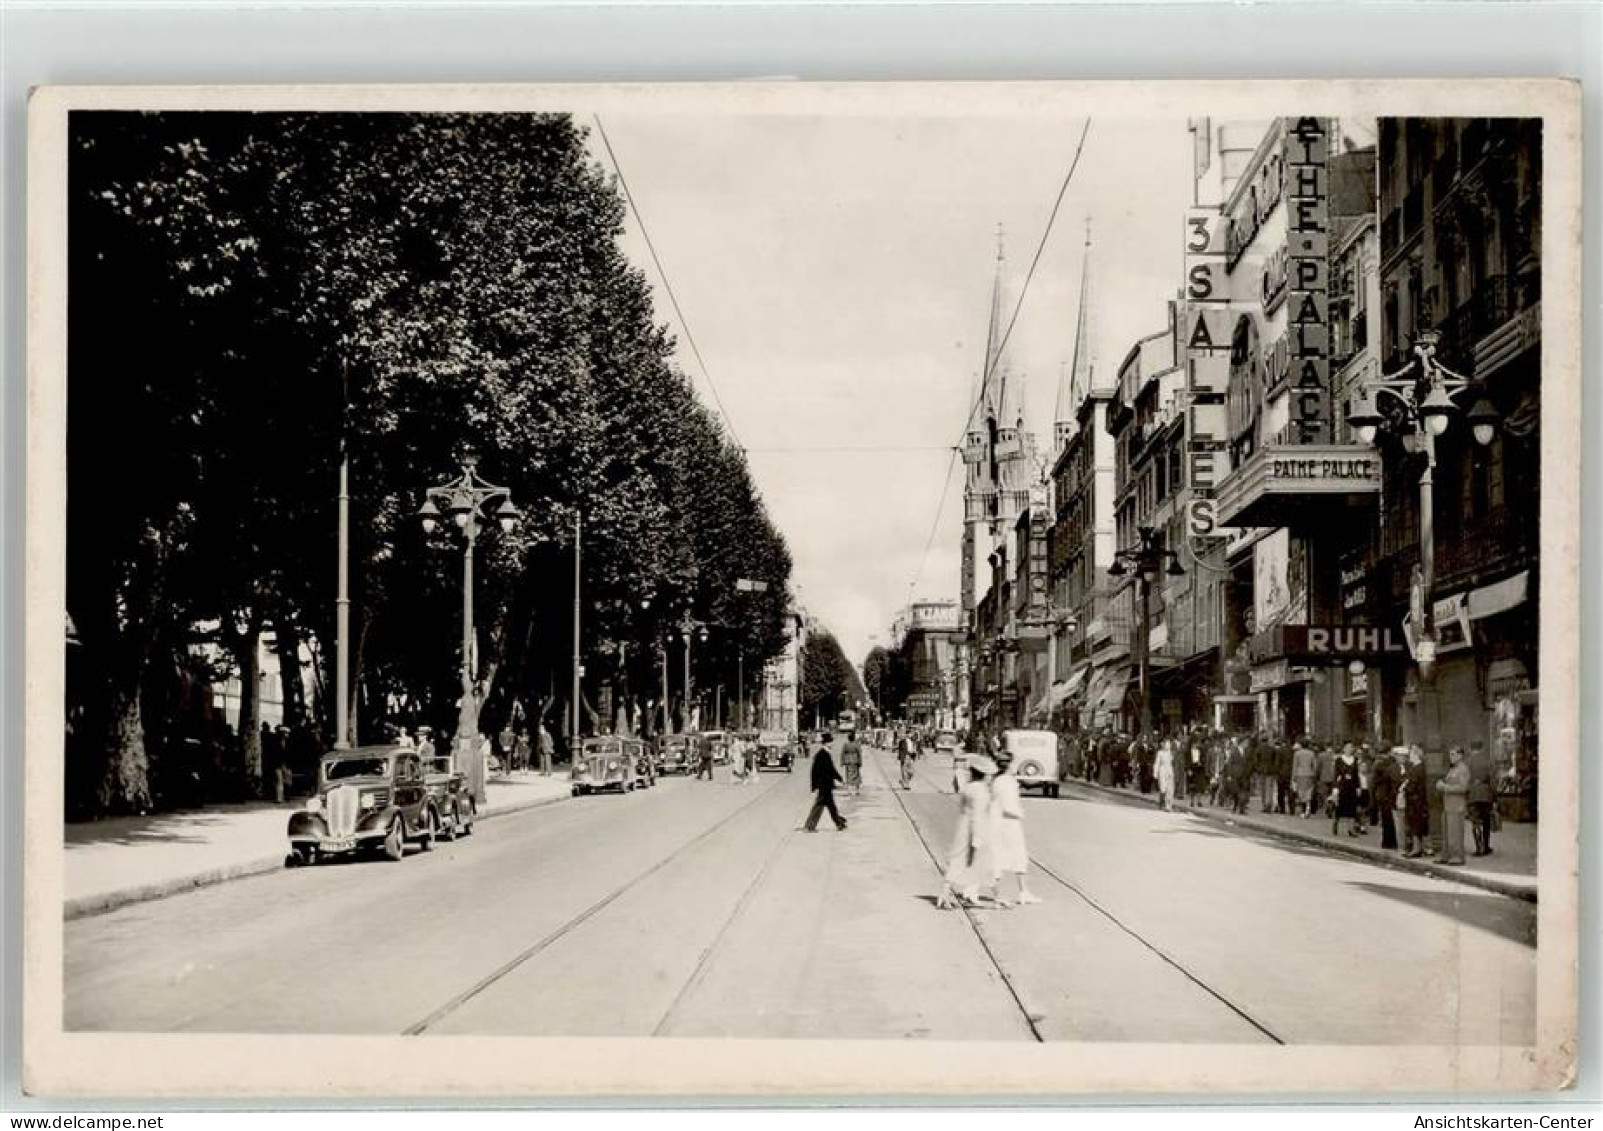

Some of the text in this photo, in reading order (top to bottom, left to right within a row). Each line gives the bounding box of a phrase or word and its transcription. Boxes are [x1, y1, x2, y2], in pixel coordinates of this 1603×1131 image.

[1188, 217, 1213, 535] 3 SALLES
[1273, 460, 1372, 479] PATHE PALACE
[1308, 628, 1404, 652] RUHL
